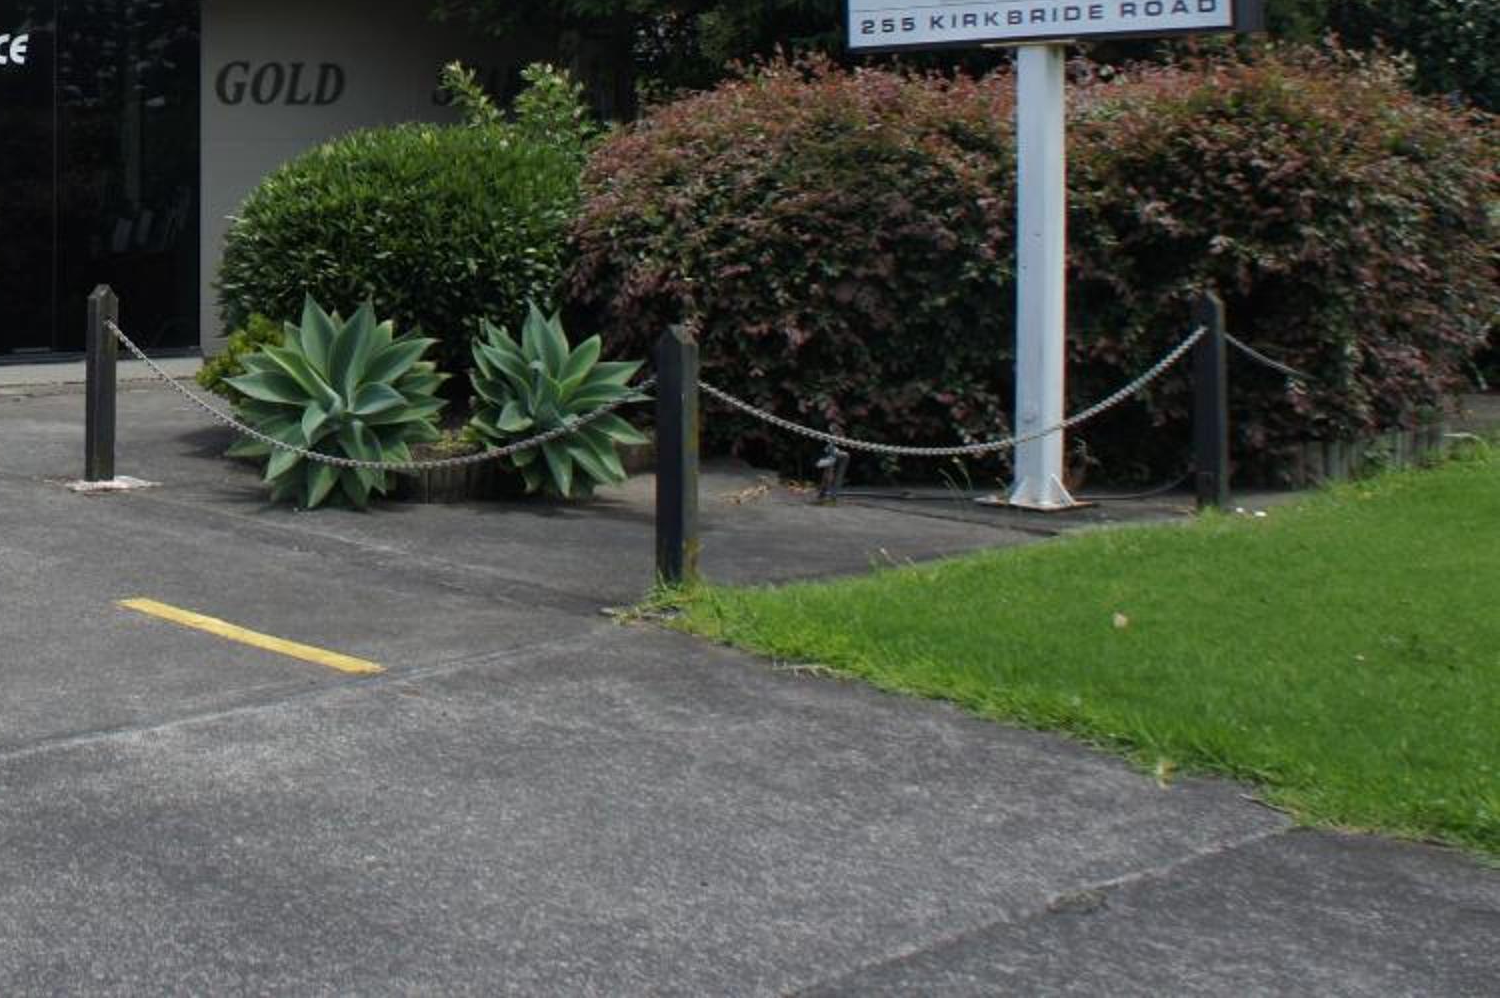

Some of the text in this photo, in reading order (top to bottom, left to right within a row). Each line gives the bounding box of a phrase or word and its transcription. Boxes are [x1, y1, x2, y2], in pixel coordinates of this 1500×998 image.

[861, 16, 916, 35] 255
[930, 4, 1104, 30] KIRKBRIDE
[214, 59, 346, 106] GOLD
